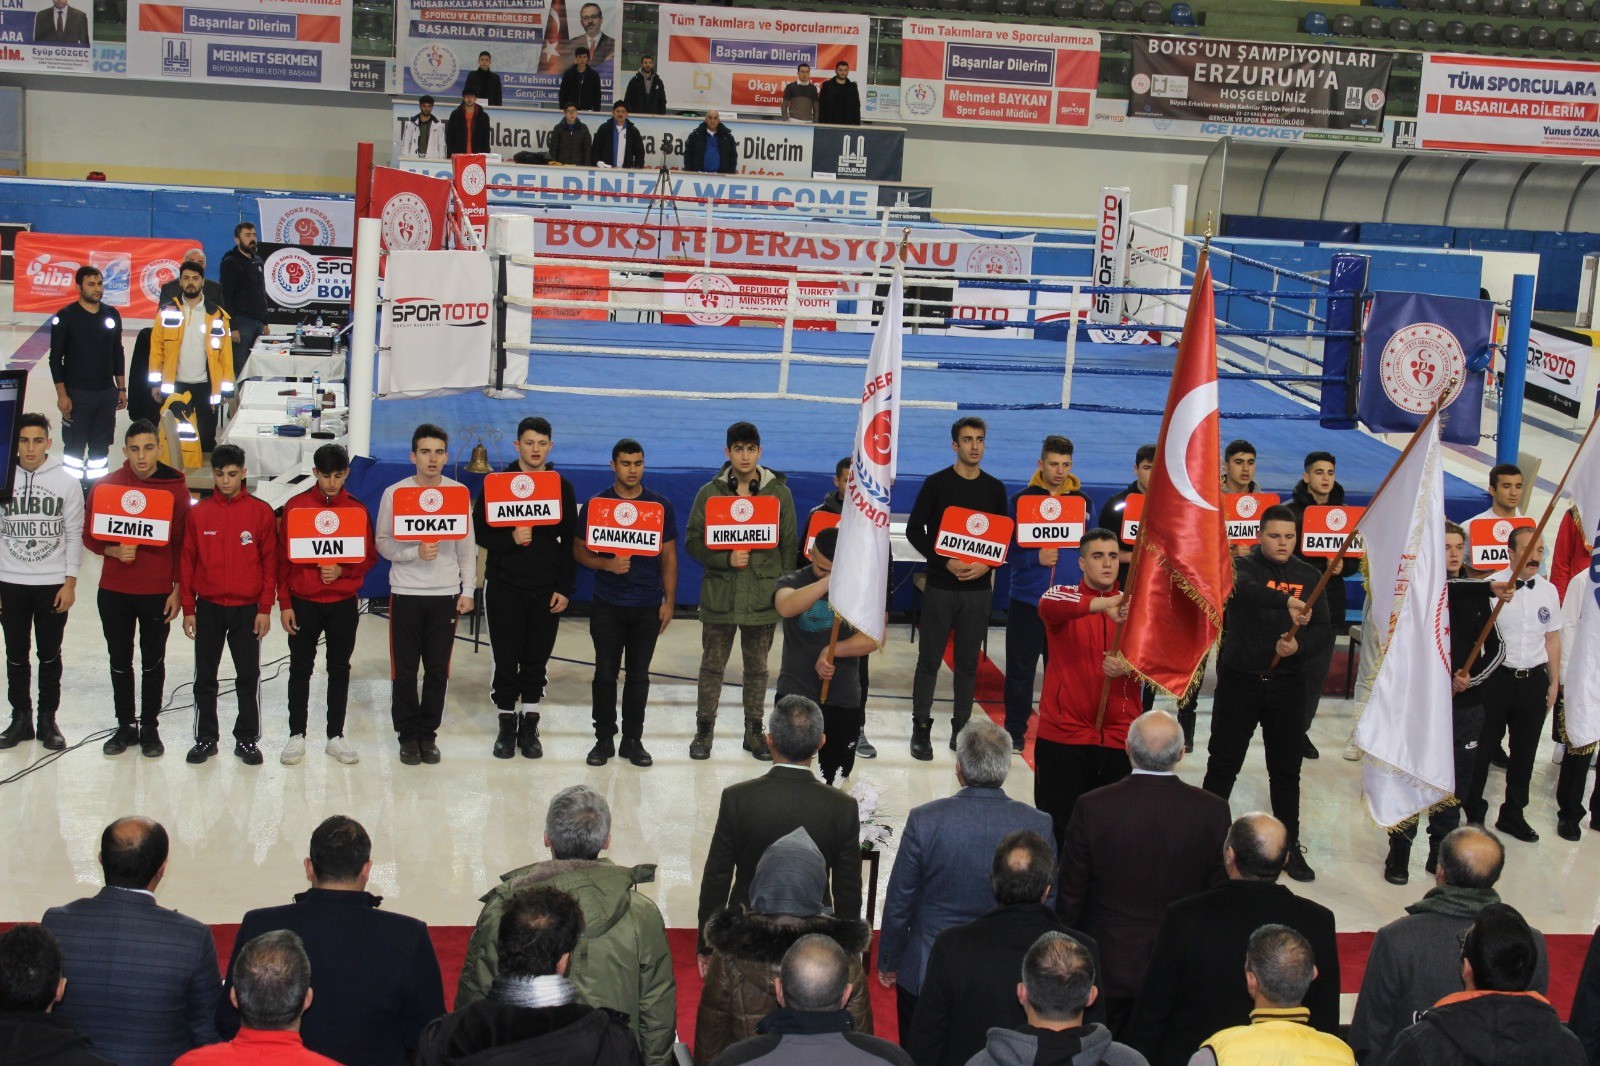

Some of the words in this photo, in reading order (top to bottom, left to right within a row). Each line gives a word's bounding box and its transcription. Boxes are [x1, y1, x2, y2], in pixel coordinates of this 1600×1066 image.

[189, 14, 244, 30] Başarılar
[248, 18, 291, 33] Dilerim
[425, 11, 457, 20] SPORCU
[458, 12, 469, 21] VE
[470, 12, 534, 23] ANTRENÖRLERE
[670, 13, 695, 26] Tüm
[698, 15, 755, 30] Takımlara
[758, 22, 772, 30] ve
[775, 19, 860, 35] Sporcularımıza
[418, 23, 485, 38] BAŞARILAR
[910, 23, 934, 35] Tüm
[938, 25, 993, 40] Takımlara
[996, 31, 1009, 40] ve
[1012, 29, 1094, 46] Sporcularımıza
[32, 47, 53, 57] Eyüp
[55, 47, 89, 58] GÖZGEÇ
[213, 49, 266, 64] MEHMET
[266, 53, 318, 67] SEKMEN
[715, 45, 767, 61] Başarılar
[770, 48, 811, 62] Dilerim
[1237, 44, 1376, 68] ŞAMPİYONLARI
[952, 54, 1004, 72] Başarılar
[1007, 58, 1048, 73] Dilerim
[504, 74, 517, 84] Dr.
[519, 75, 557, 86] Mehmet
[747, 78, 778, 95] Okay
[1448, 70, 1485, 90] TÜM
[1487, 76, 1597, 96] SPORCULARA
[515, 89, 547, 100] Gençlik
[548, 91, 558, 99] ve
[949, 89, 996, 104] Mehmet
[999, 92, 1047, 107] BAYKAN
[1220, 88, 1307, 104] HOŞGELDİNİZ
[956, 105, 976, 118] Spor
[978, 106, 1004, 118] Genel
[1005, 107, 1038, 119] Müdürü
[1454, 99, 1529, 116] BAŞARILAR
[1530, 101, 1586, 118] DİLERİM
[1200, 123, 1229, 135] ICE
[1231, 125, 1303, 140] HOCKEY
[1543, 126, 1571, 136] Yunus
[743, 135, 804, 163] Dilerim
[693, 181, 868, 216] WELCOME
[284, 207, 304, 218] BOKS
[545, 221, 657, 250] BOKS
[671, 228, 959, 267] FEDERASYONU
[33, 267, 73, 287] aiba
[799, 287, 834, 297] TURKEY
[739, 296, 782, 306] MINISTRY
[798, 298, 830, 308] YOUTH
[497, 502, 551, 518] ANKARA
[107, 517, 154, 538] İZMİR
[404, 517, 457, 532] TOKAT
[1032, 526, 1070, 539] ORDU
[592, 528, 657, 546] ÇANAKKALE
[713, 525, 770, 543] KIRKLARELİ
[311, 539, 344, 556] VAN
[940, 534, 1003, 559] ADIYAMAN
